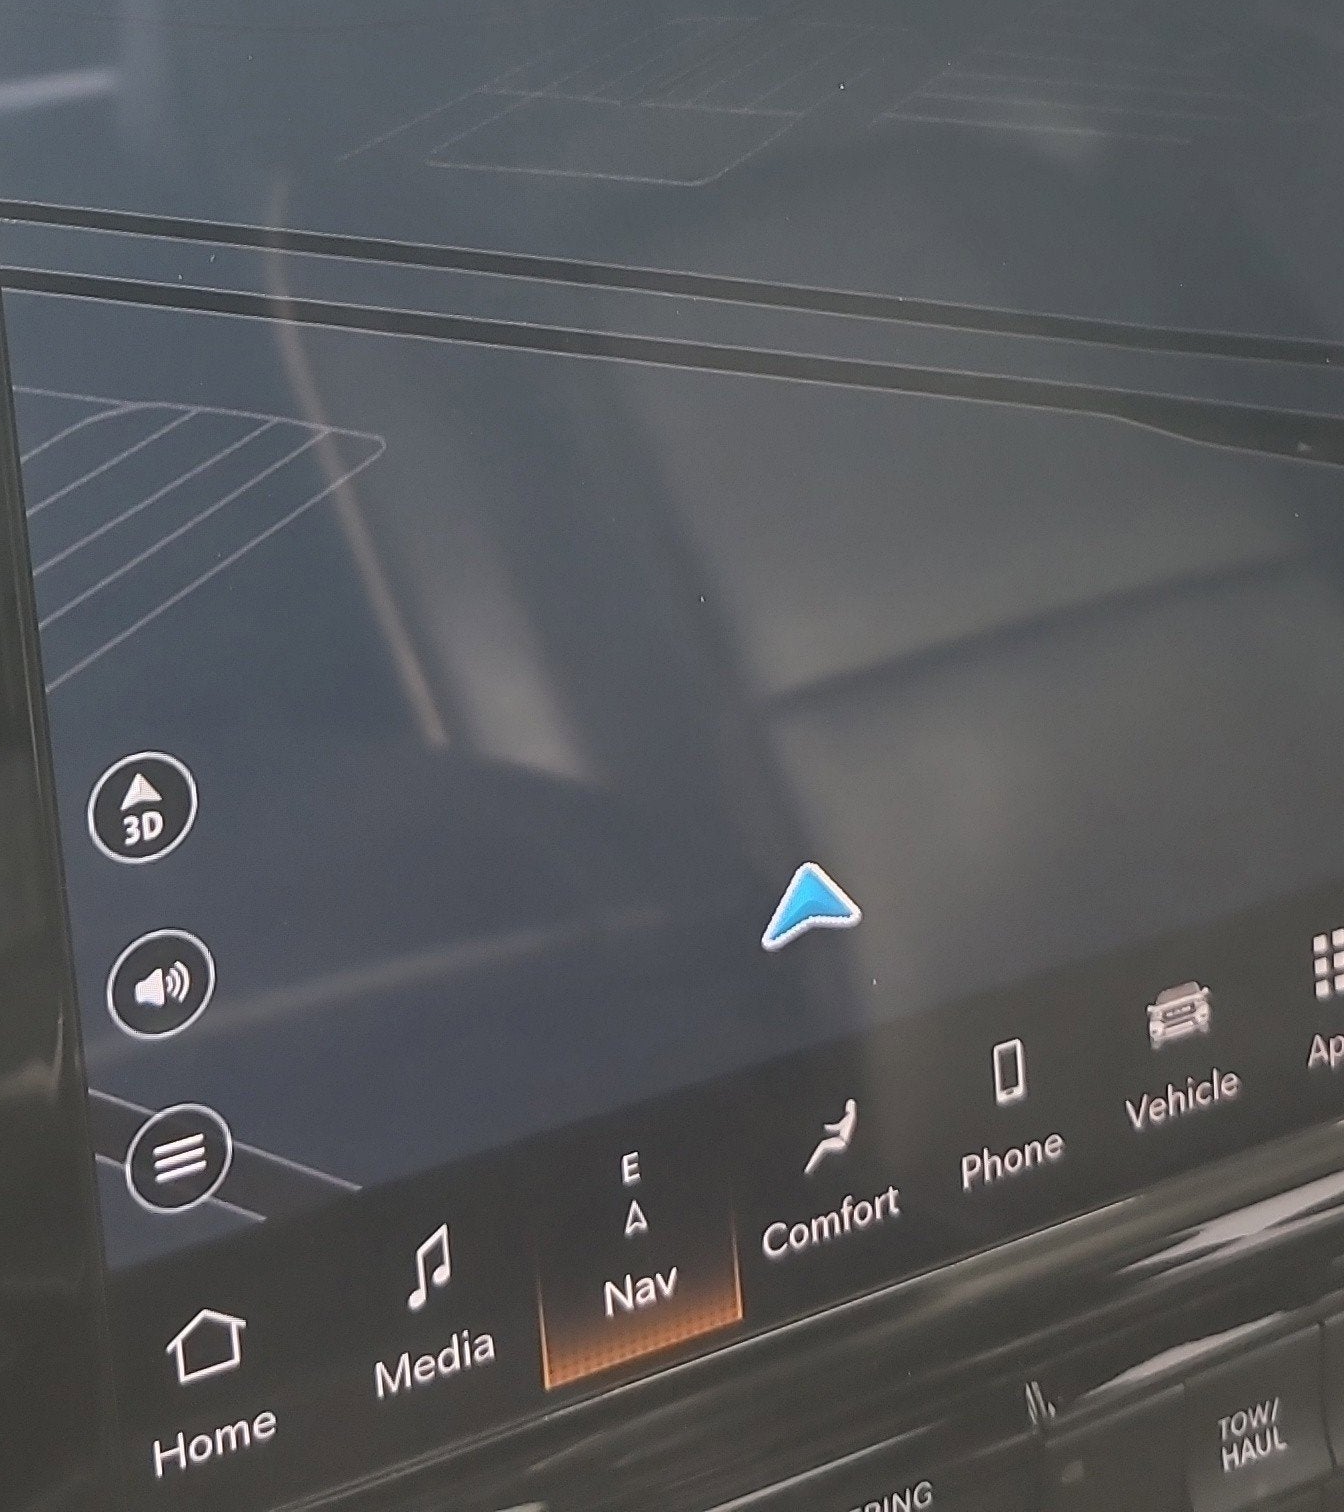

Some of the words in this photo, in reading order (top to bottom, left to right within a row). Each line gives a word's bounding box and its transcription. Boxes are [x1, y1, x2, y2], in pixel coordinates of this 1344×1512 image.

[122, 811, 164, 845] 3D
[1124, 1067, 1240, 1130] Vehicle
[620, 1151, 639, 1183] E
[961, 1131, 1065, 1190] Phone
[761, 1185, 901, 1260] Comfort
[603, 1265, 679, 1318] Nav
[374, 1328, 496, 1399] Media
[151, 1407, 278, 1478] Home
[1218, 1396, 1279, 1442] TOW/
[1221, 1425, 1287, 1474] HAUL
